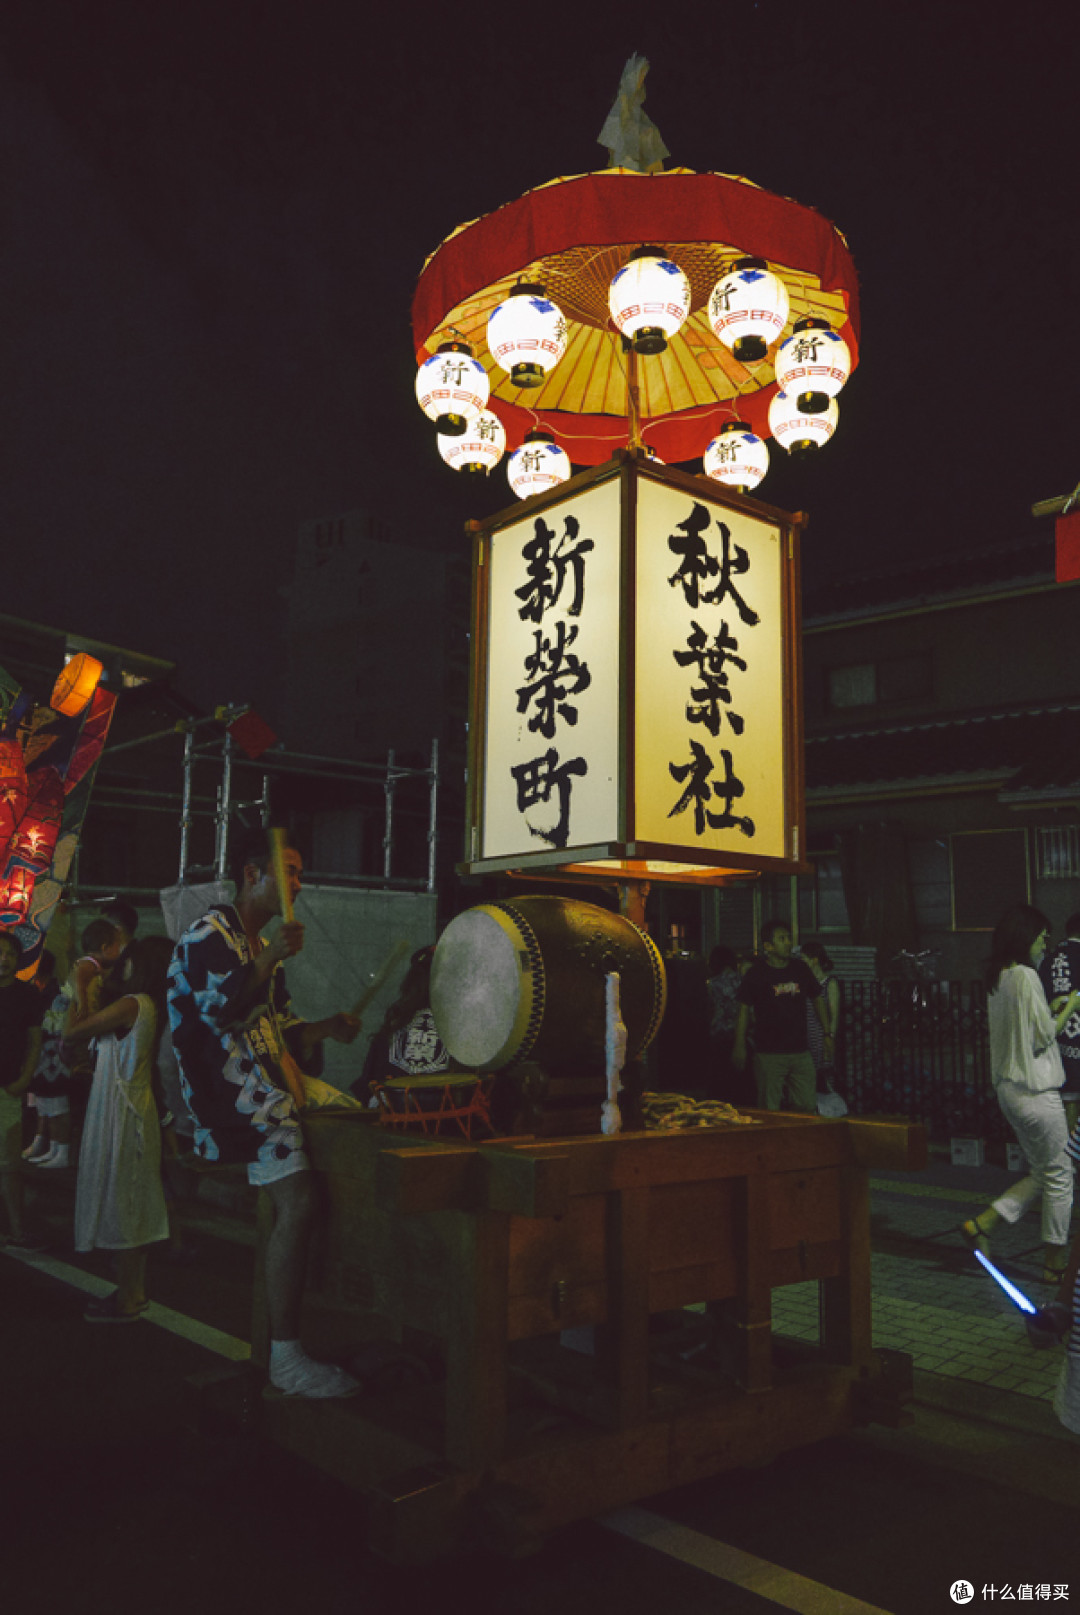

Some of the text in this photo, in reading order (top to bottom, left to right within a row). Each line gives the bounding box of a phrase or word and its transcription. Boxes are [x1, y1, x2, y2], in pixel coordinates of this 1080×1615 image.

[790, 336, 825, 363] 新
[667, 501, 760, 838] 秋葉社
